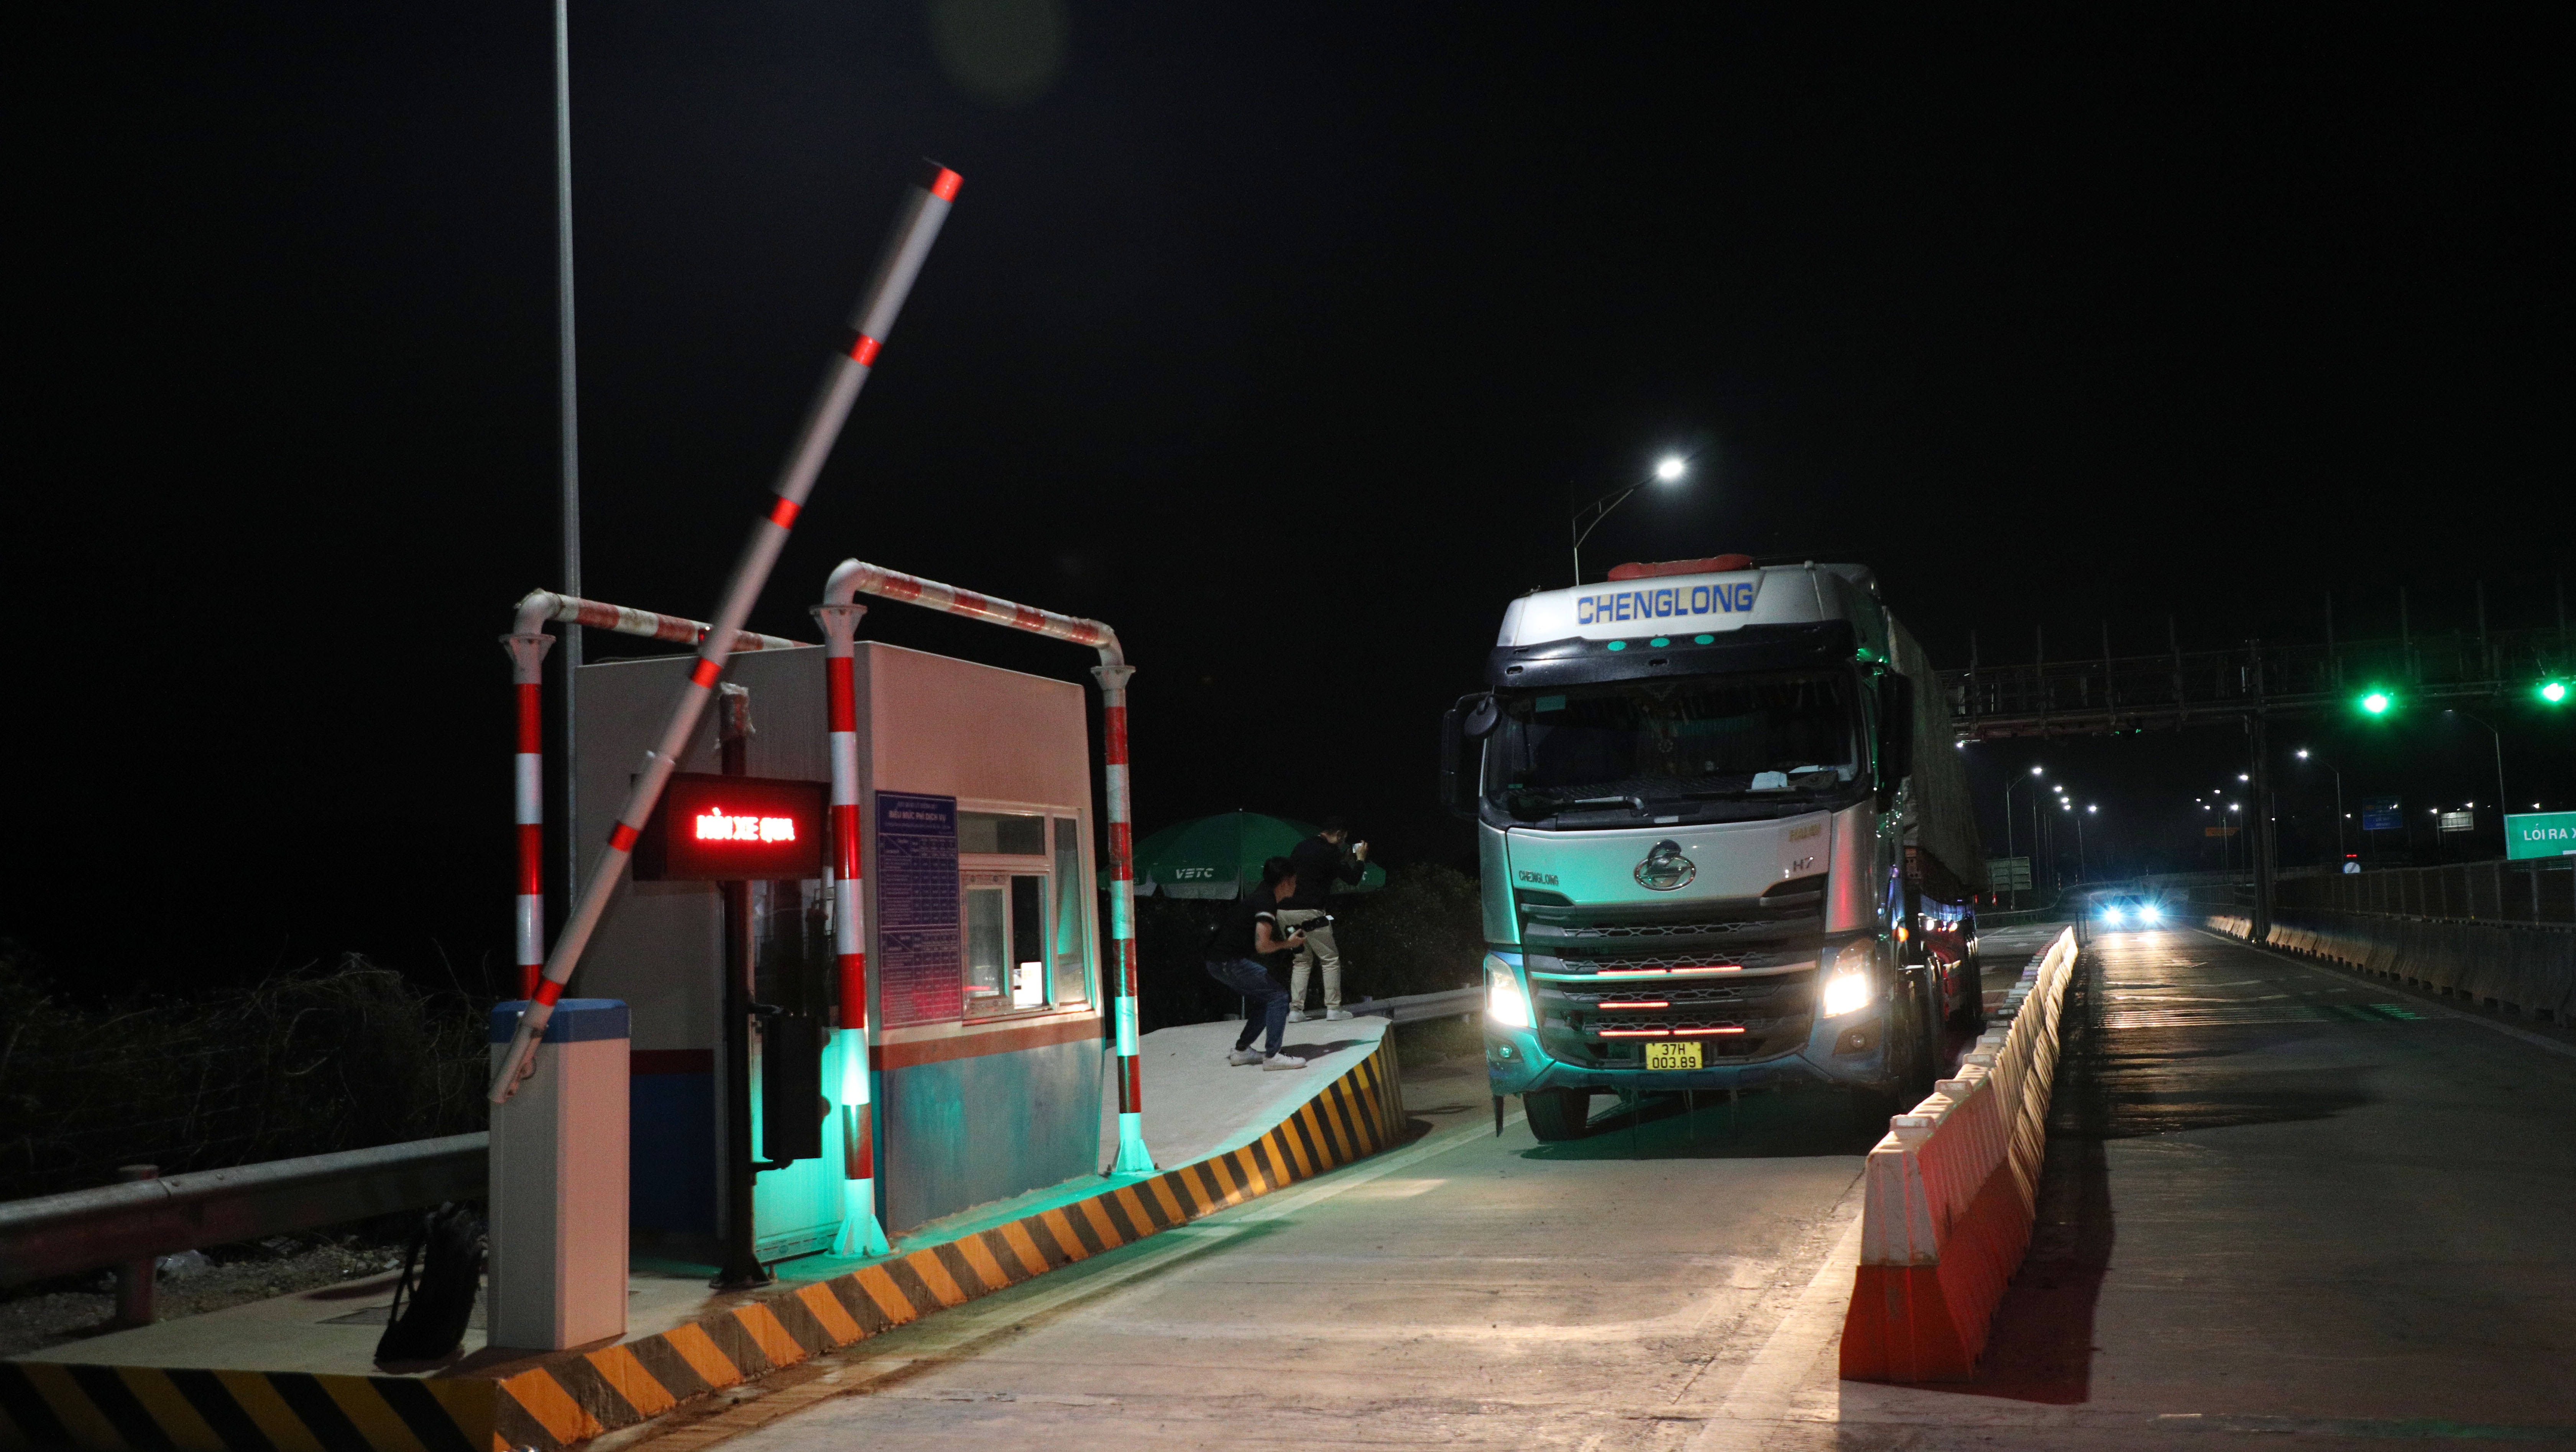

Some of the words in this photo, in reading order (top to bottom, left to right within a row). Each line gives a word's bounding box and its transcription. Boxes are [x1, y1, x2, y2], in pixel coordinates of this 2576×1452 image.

[1578, 583, 1753, 625] CHENGLONG
[733, 816, 759, 840] XE
[760, 817, 795, 843] QUA
[2523, 823, 2545, 840] LỐI
[2548, 828, 2568, 840] RA
[1793, 856, 1814, 872] H7
[1176, 867, 1214, 879] VETC
[1519, 870, 1559, 886] CHENGLONG
[1662, 1043, 1685, 1055] 37H
[1653, 1056, 1695, 1068] 003.89
